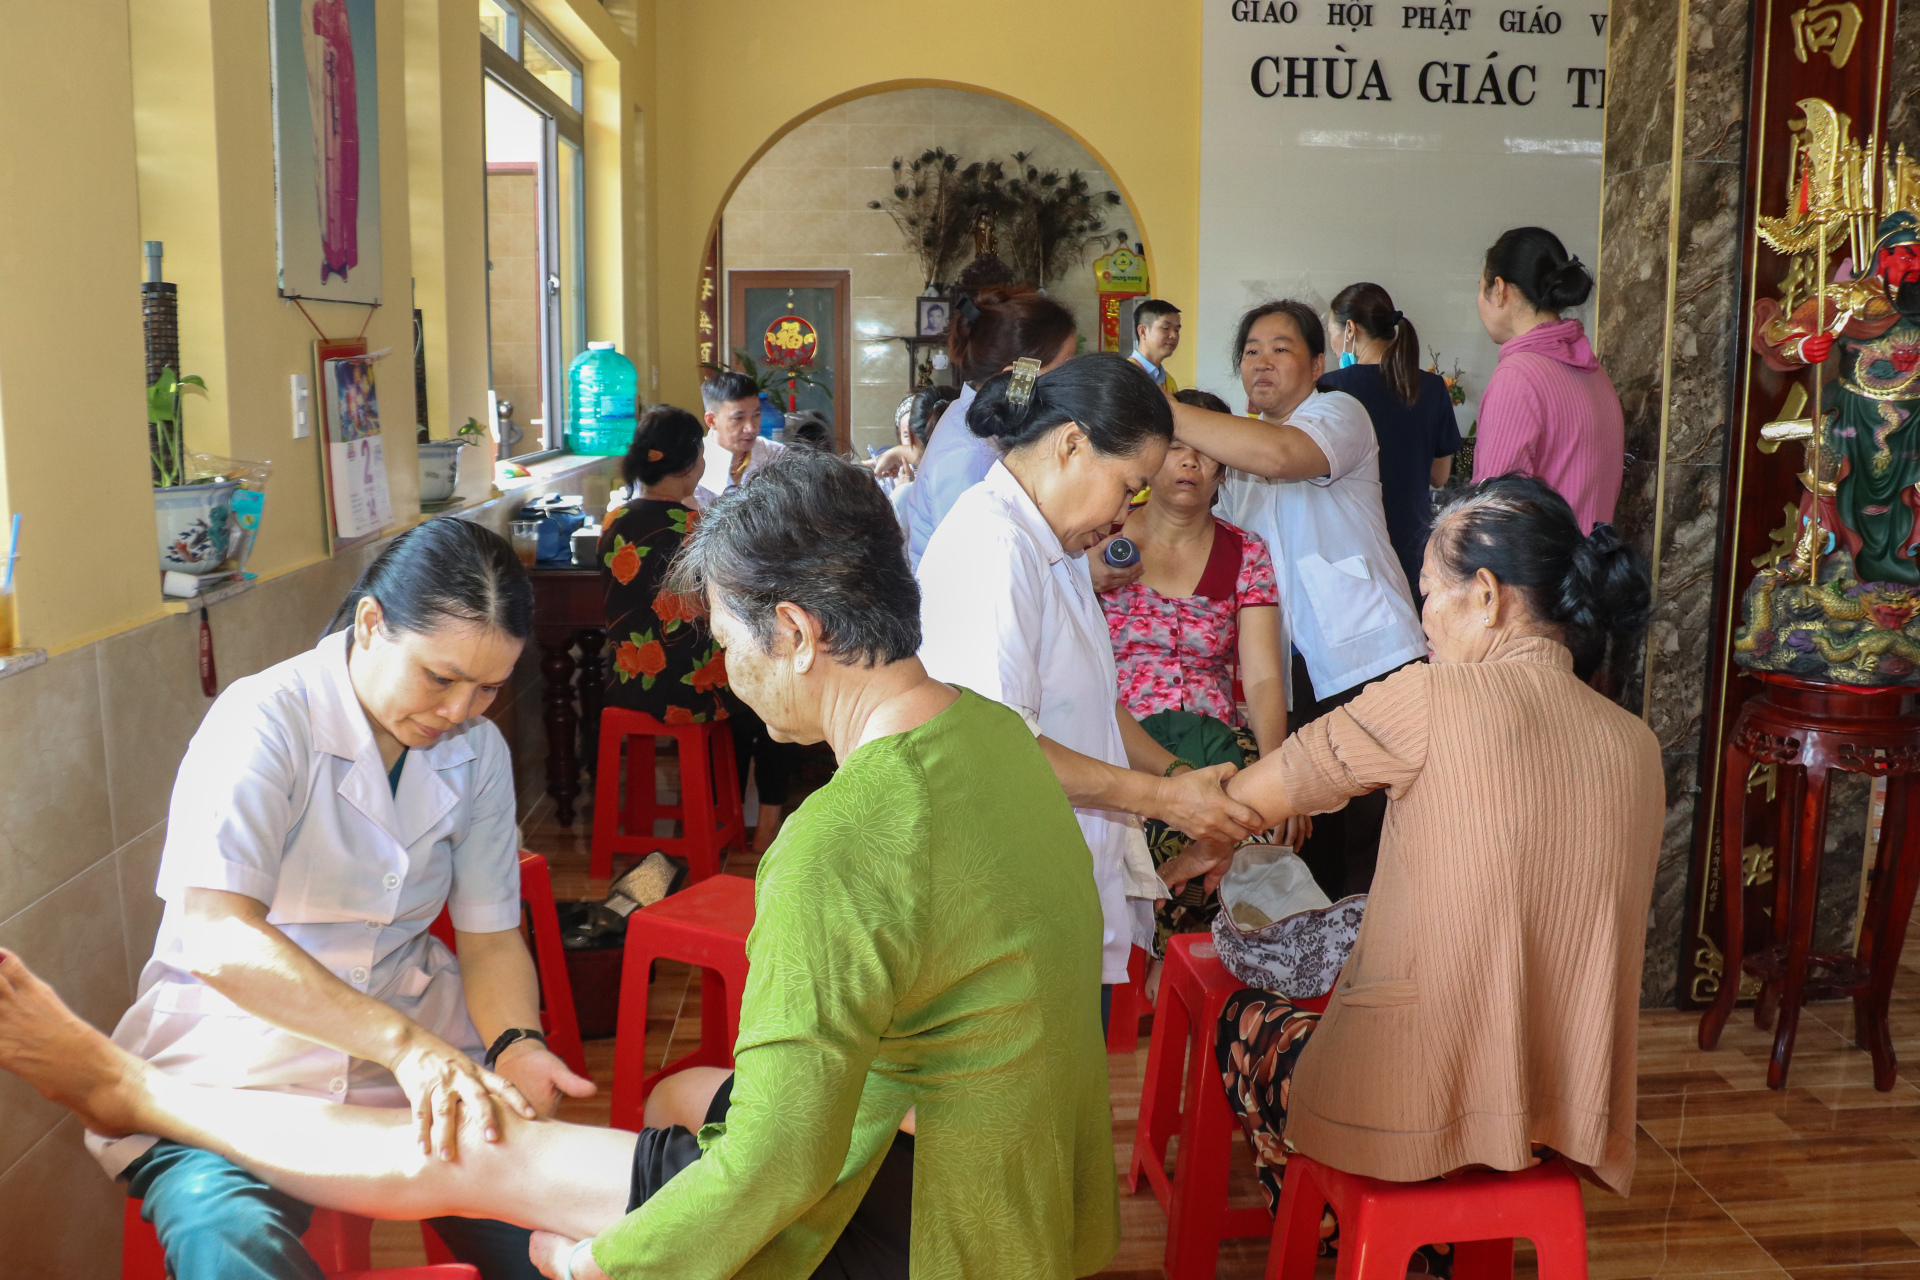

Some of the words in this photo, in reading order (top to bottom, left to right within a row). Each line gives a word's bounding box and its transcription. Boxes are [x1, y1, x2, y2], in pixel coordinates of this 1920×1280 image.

[1401, 0, 1471, 36] PHẬT
[1499, 4, 1562, 35] GIÁO
[1250, 44, 1392, 101] CHÙA
[1418, 51, 1536, 107] GIÁC
[775, 321, 803, 349] 福
[362, 440, 373, 484] 2
